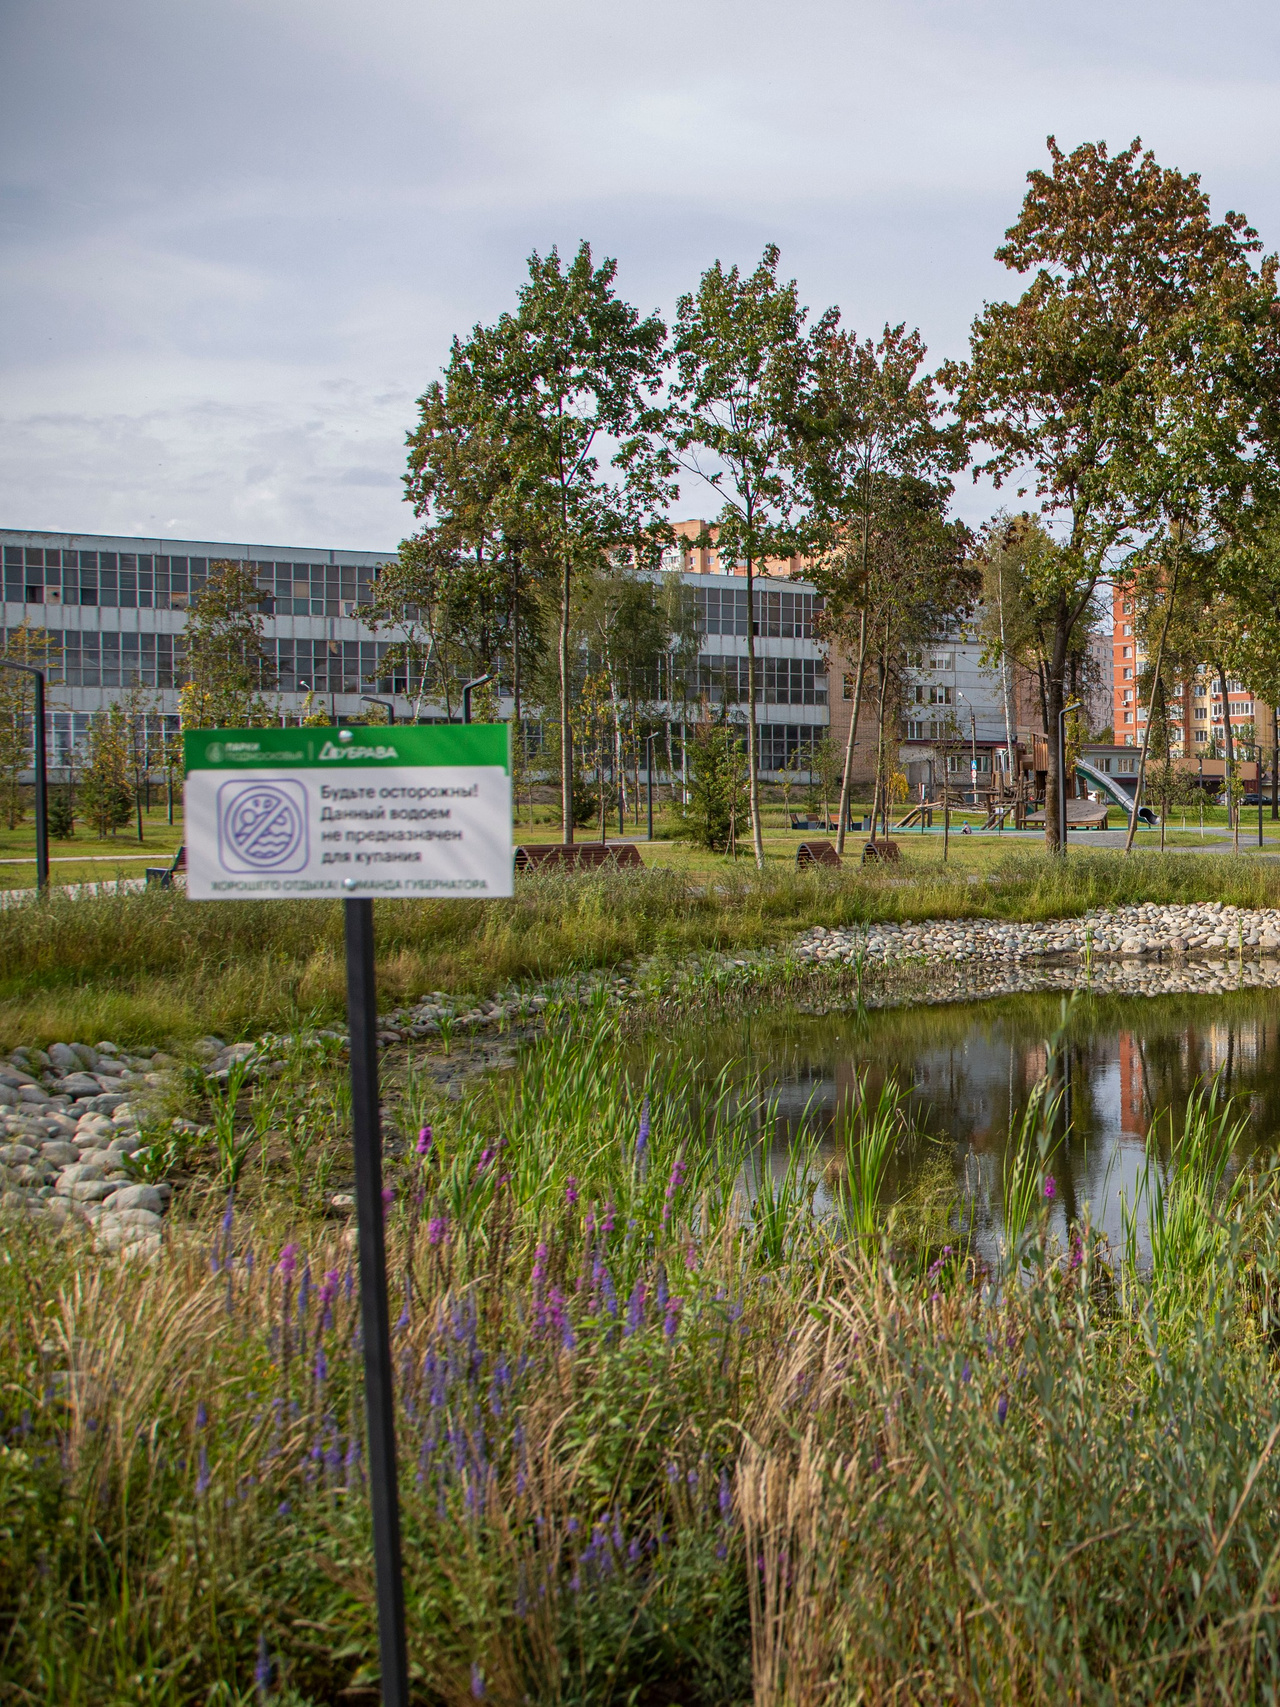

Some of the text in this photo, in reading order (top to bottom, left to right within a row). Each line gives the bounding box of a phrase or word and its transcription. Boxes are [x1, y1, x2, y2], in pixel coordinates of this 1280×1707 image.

[320, 783, 478, 801] Будьте осторожны!
[320, 806, 451, 821] Данный водоем
[321, 829, 463, 844] не предназначен
[321, 851, 422, 865] для купания
[211, 880, 281, 891] ХОРОШЕГО
[404, 879, 488, 890] ГУБЕРНАТОРА
